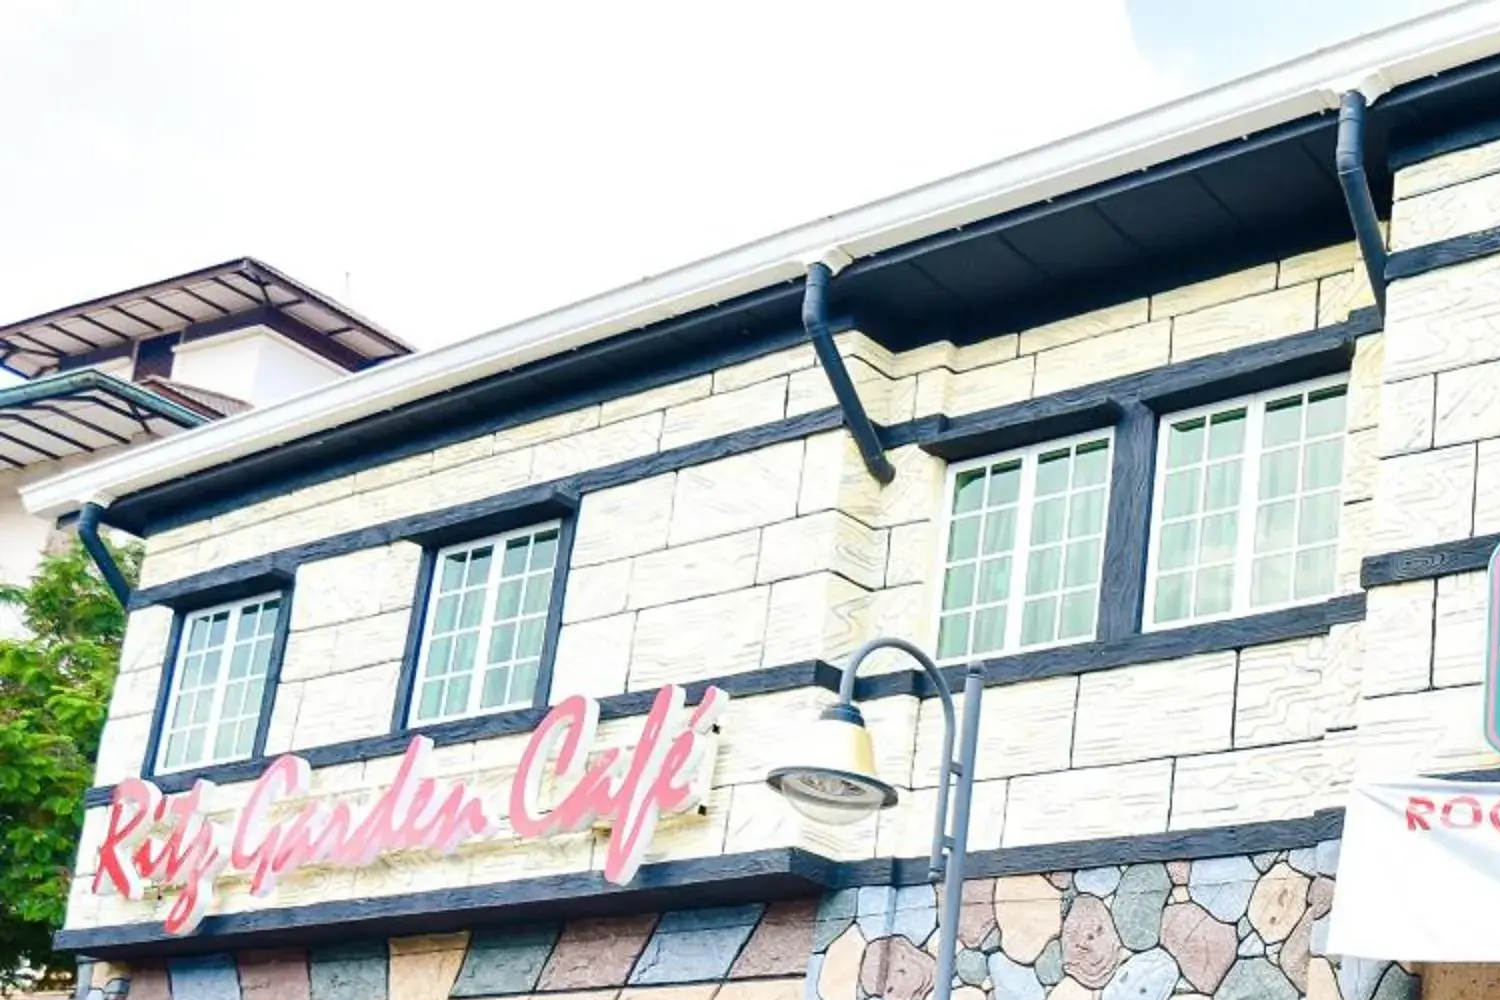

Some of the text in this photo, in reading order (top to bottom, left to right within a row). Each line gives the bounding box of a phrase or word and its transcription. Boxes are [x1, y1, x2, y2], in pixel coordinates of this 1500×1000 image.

[93, 684, 728, 935] Ritz Garden Café
